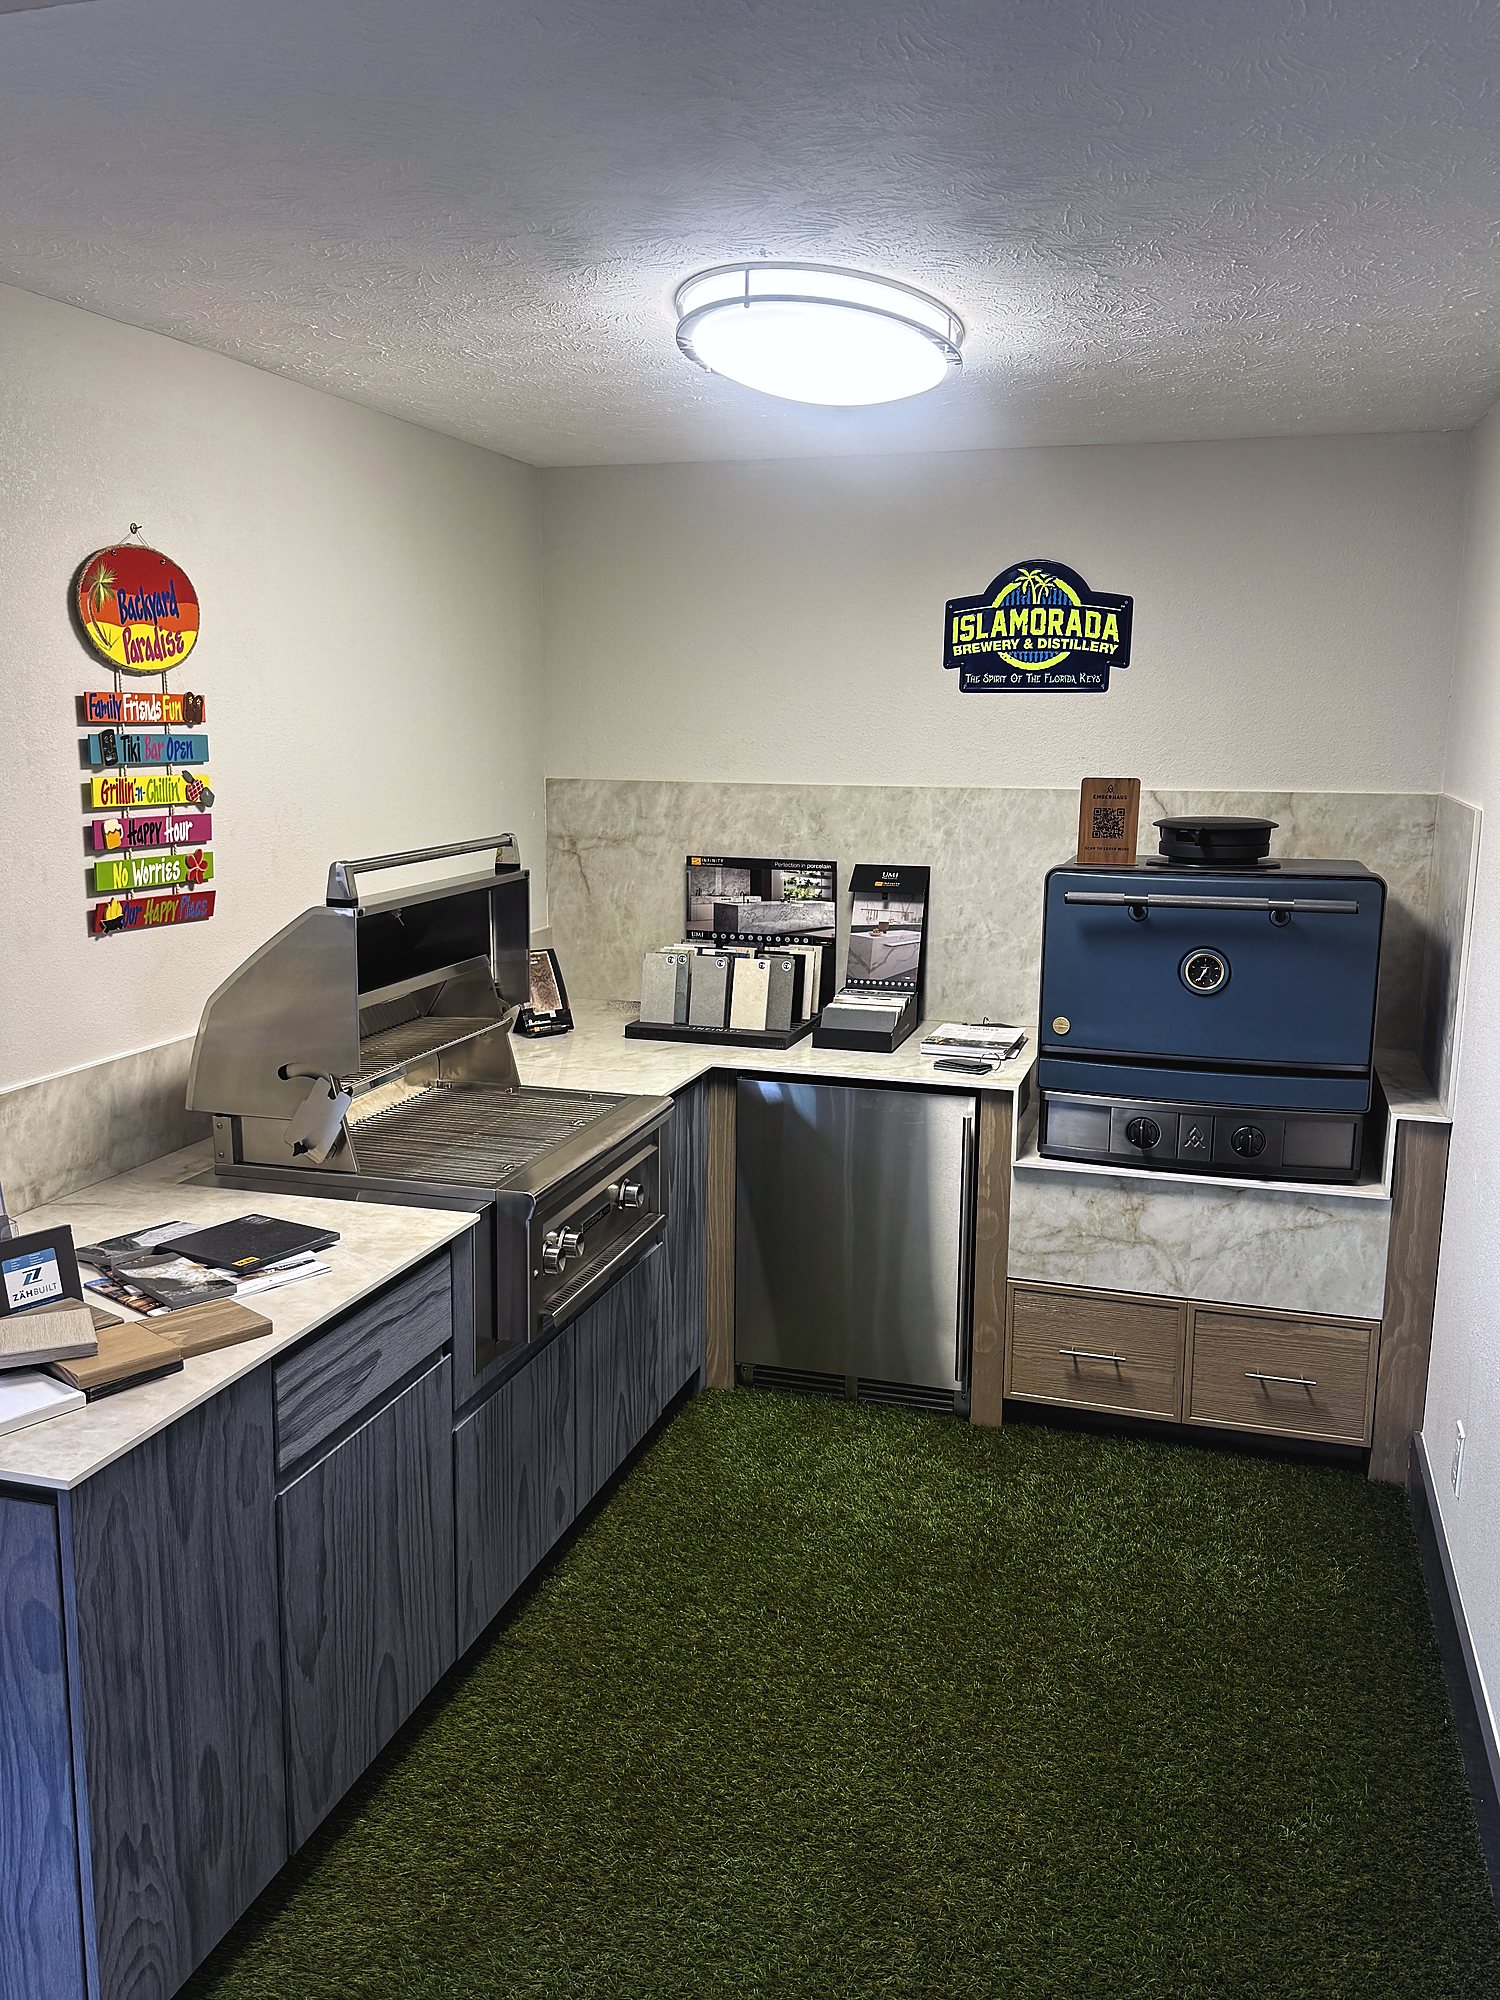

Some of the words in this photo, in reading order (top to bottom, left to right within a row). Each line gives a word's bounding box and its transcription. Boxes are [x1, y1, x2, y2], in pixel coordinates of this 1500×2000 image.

[117, 578, 180, 625] Backyard
[952, 607, 1120, 644] ISLAMORADA
[122, 625, 185, 664] Paradise
[952, 638, 1020, 656] BREWERY
[1023, 639, 1034, 650] &
[1037, 638, 1119, 655] DISTILLERY
[964, 673, 981, 684] THE
[1025, 673, 1041, 684] THE
[88, 692, 122, 720] Family
[122, 693, 161, 721] Friends
[162, 695, 183, 721] Fun
[120, 734, 141, 762] Tiki
[144, 735, 164, 761] Bar
[166, 737, 193, 760] Open
[164, 816, 193, 842] Hour
[113, 861, 129, 889] No
[132, 857, 180, 887] Worries
[12, 1282, 58, 1302] ZÄHBUILT
